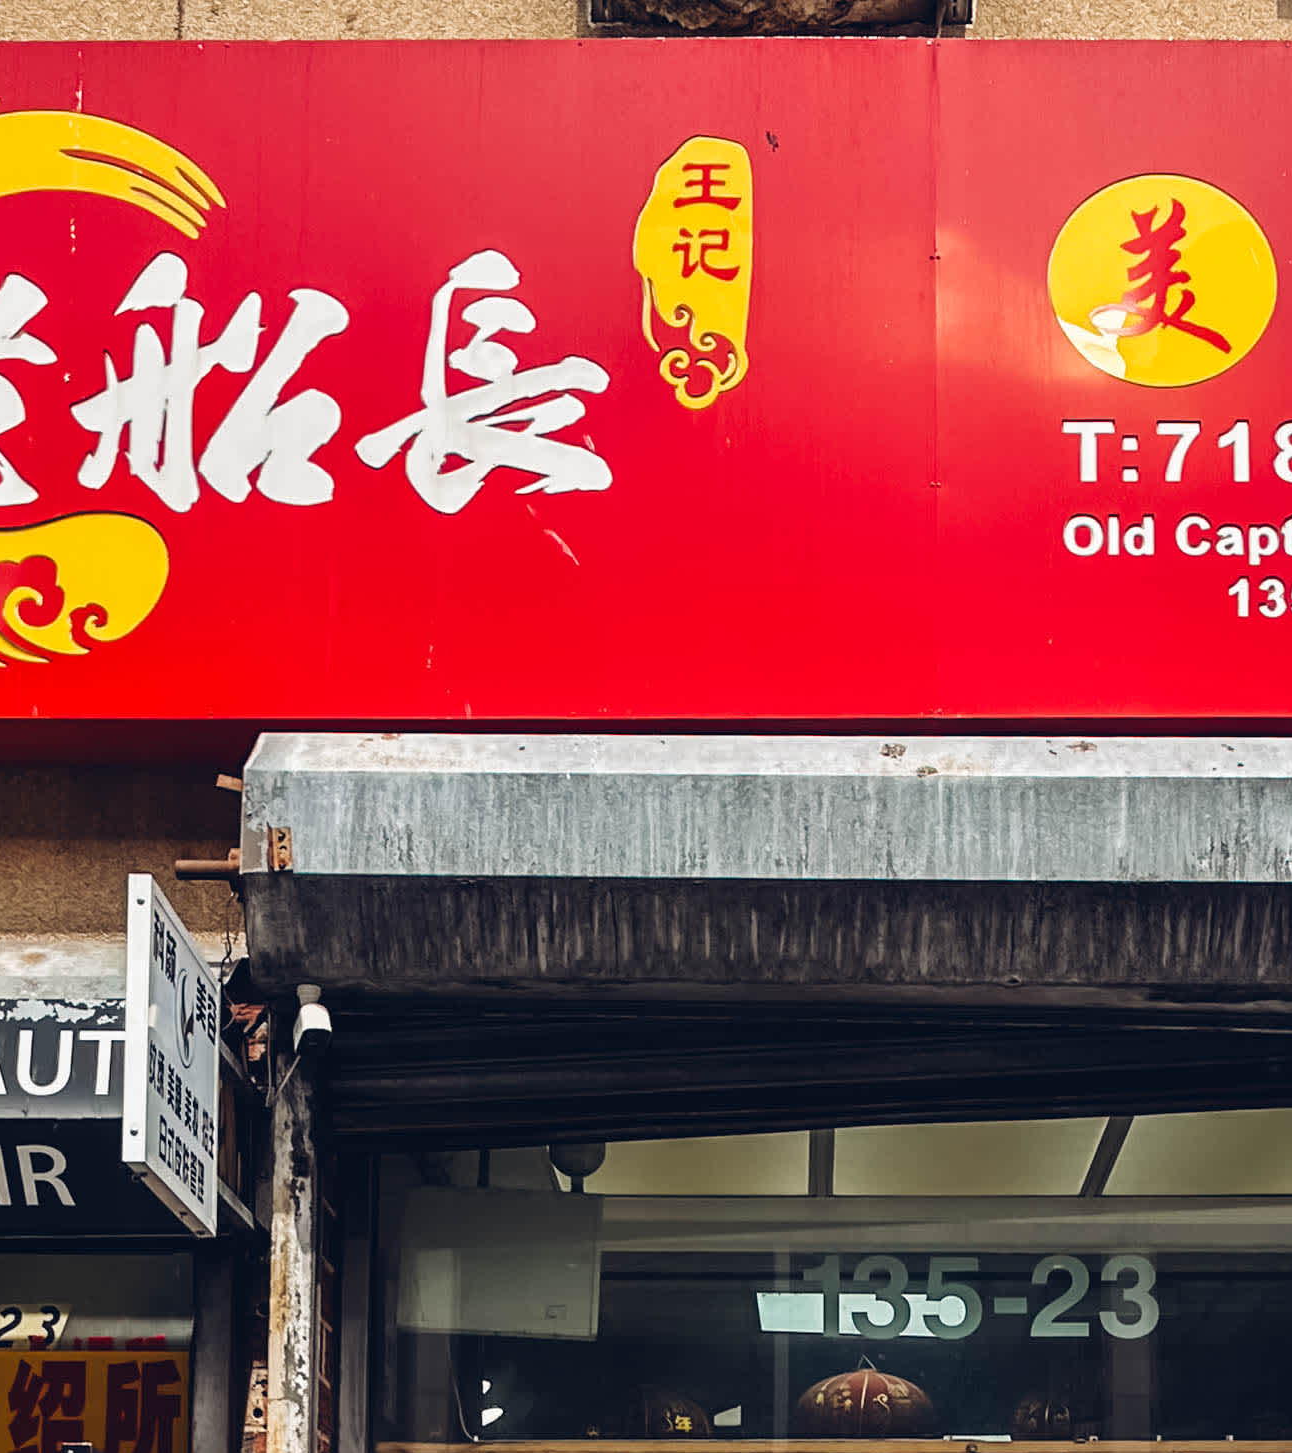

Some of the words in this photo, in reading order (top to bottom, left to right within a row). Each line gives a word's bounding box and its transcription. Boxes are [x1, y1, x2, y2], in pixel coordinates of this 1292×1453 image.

[673, 163, 742, 279] 王记
[1064, 515, 1155, 557] Old
[804, 1255, 1160, 1340] 135-23
